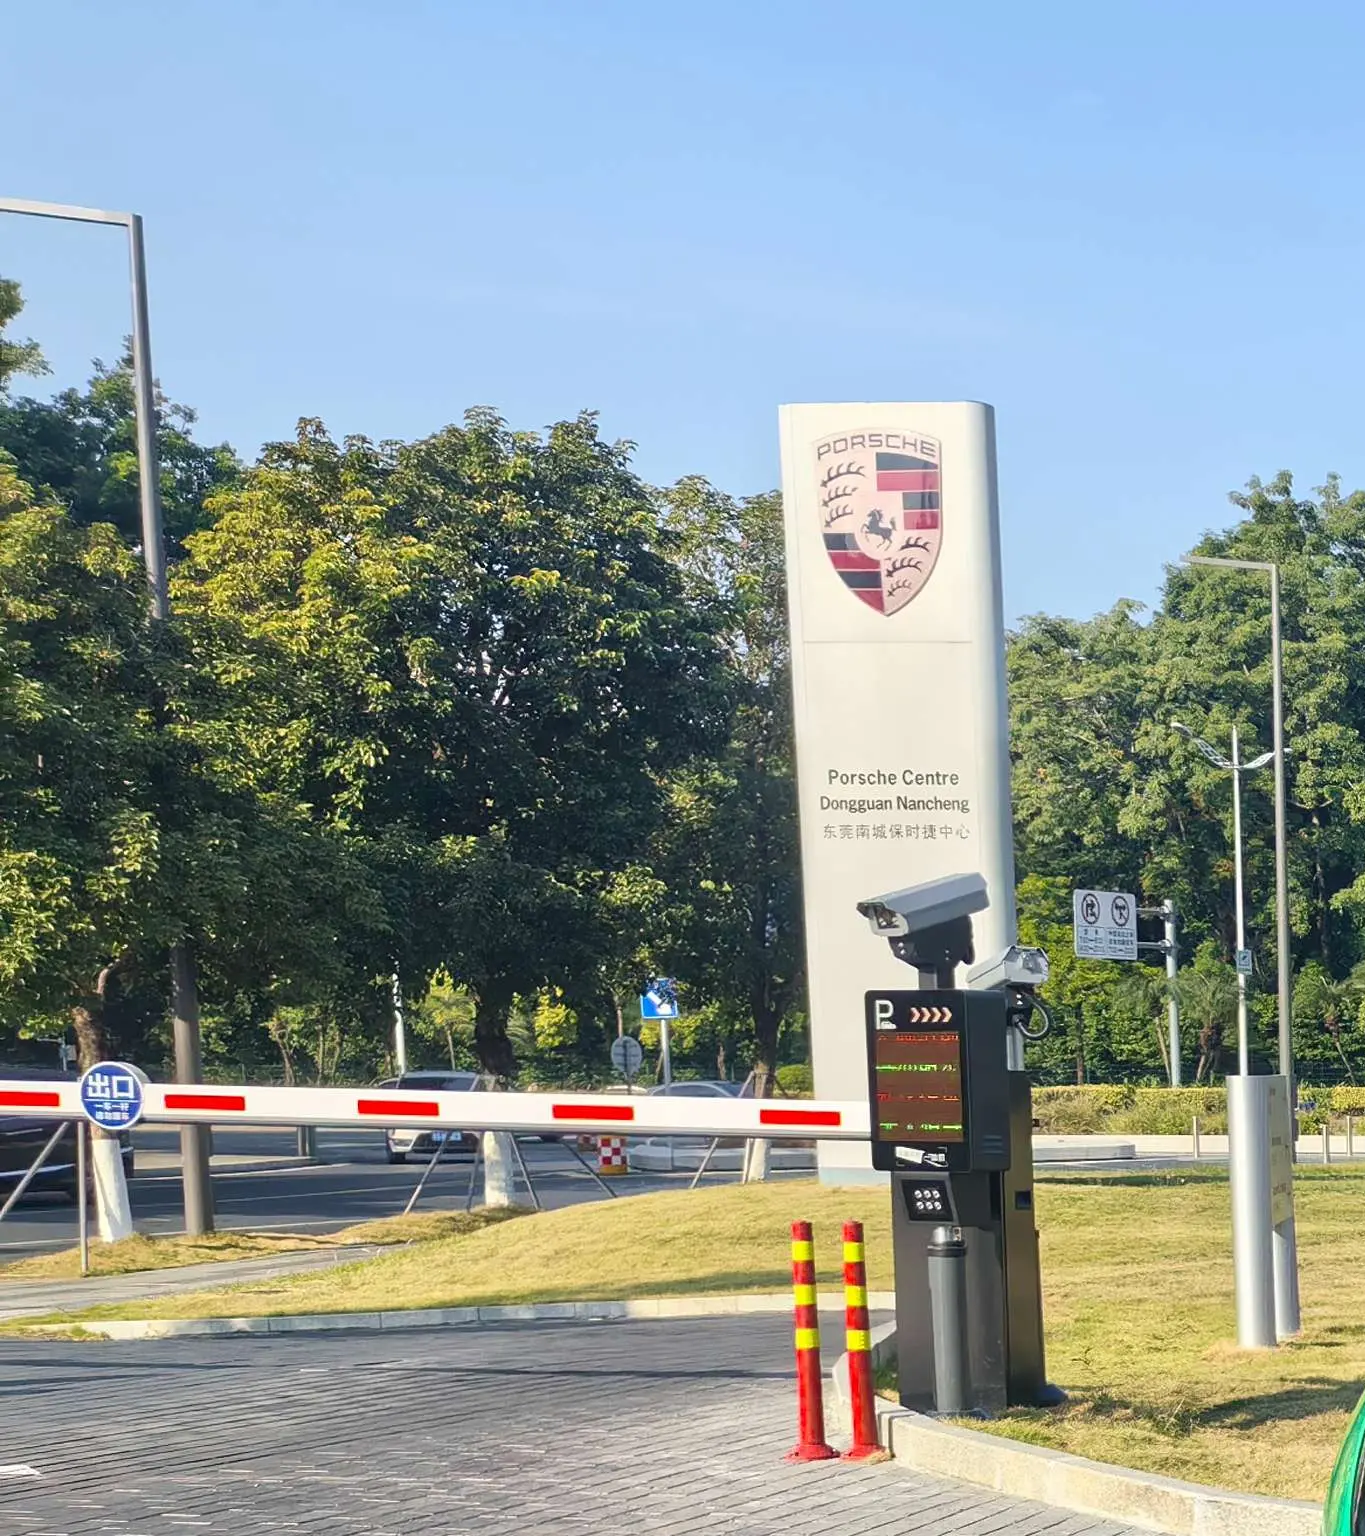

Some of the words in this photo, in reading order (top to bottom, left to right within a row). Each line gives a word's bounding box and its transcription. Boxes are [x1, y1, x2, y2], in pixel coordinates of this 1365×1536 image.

[817, 433, 937, 461] PORSCHE
[828, 769, 898, 785] Porsche
[902, 769, 959, 786] Centre
[820, 795, 893, 813] Dongguan
[897, 796, 970, 814] Nancheng
[823, 823, 971, 840] 东莞南城保时捷中心
[87, 1072, 134, 1098] 出口
